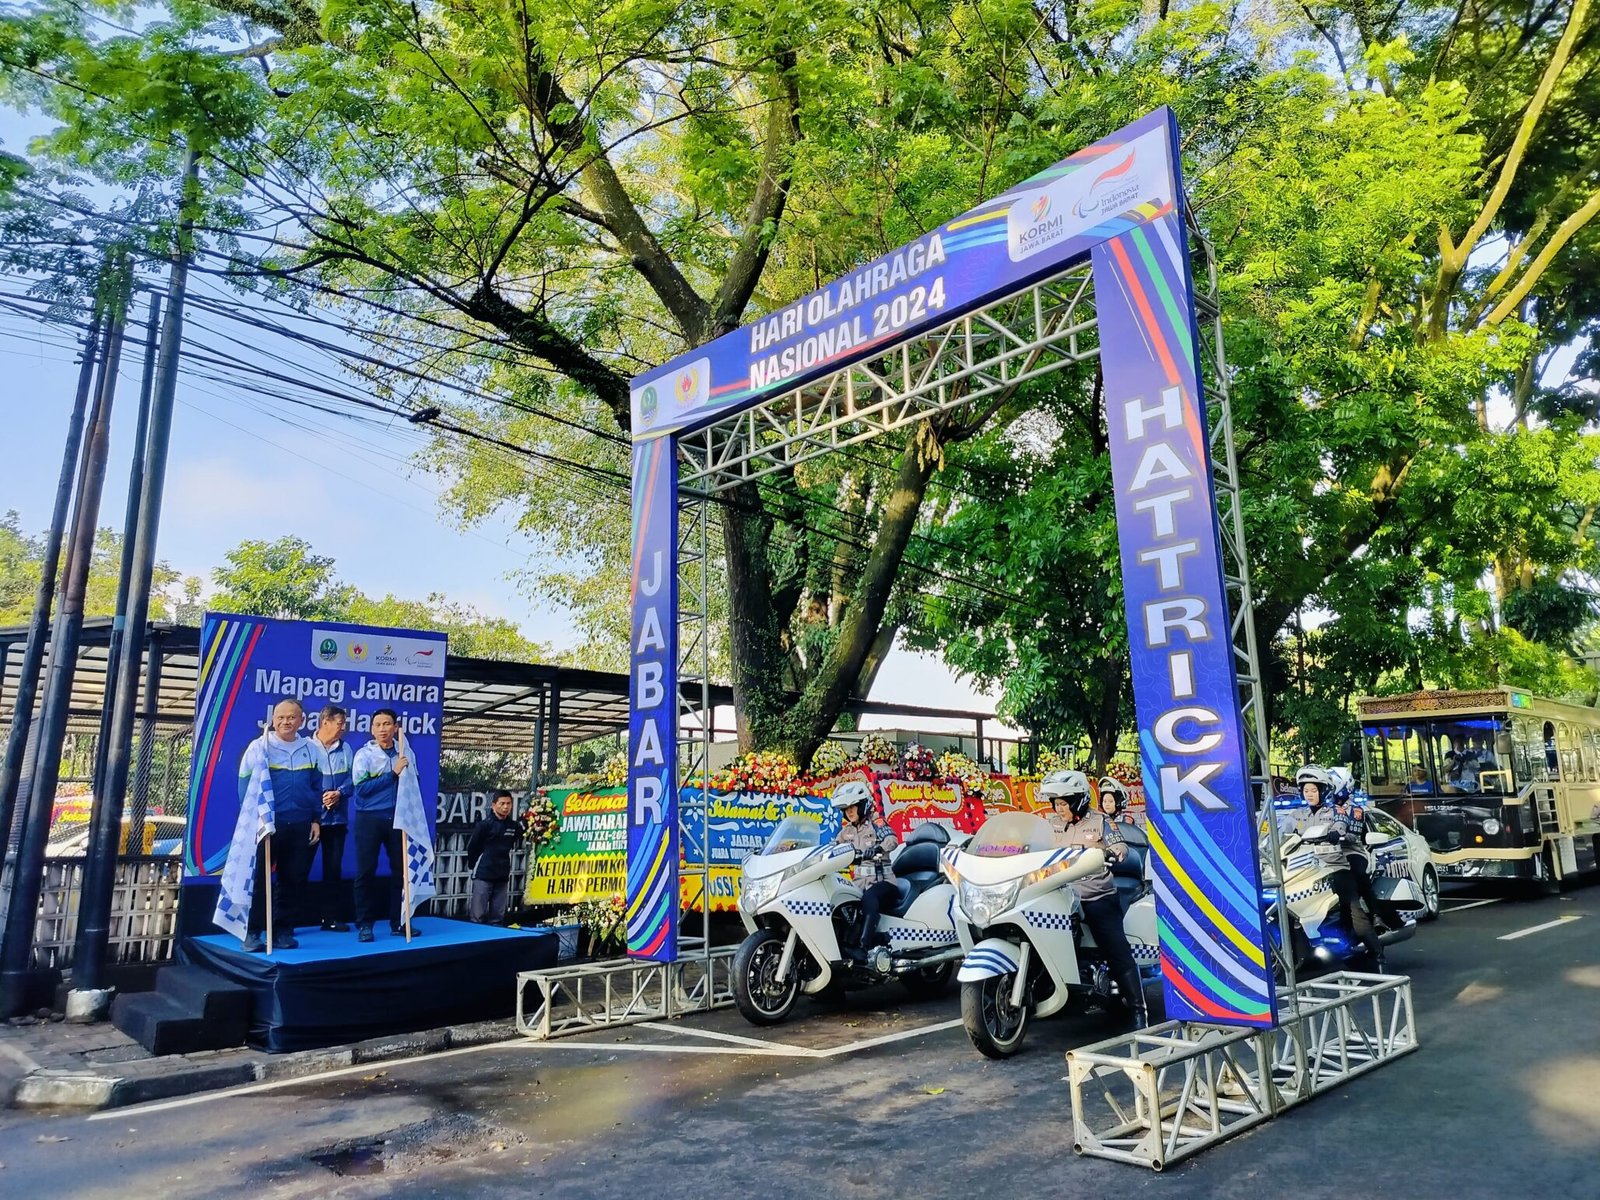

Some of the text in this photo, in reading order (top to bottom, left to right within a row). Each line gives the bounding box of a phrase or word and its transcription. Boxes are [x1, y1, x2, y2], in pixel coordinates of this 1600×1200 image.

[1019, 214, 1062, 244] KORMI
[1020, 228, 1063, 254] JAWA BARAT
[751, 234, 946, 354] HARI OLAHRAGA
[750, 276, 946, 392] NASIONAL 2024
[1124, 385, 1230, 813] HATTRICK
[255, 668, 439, 703] Mapag Jawara
[634, 550, 665, 826] JABAR
[344, 708, 436, 735] Haick
[436, 791, 527, 823] BART
[708, 799, 766, 820] Selamat
[560, 814, 591, 833] JAWA
[577, 830, 628, 842] PON XXI-202
[730, 834, 763, 848] JABAR
[536, 861, 571, 877] KETUA
[573, 859, 608, 875] UMUM
[585, 876, 627, 893] PERMO
